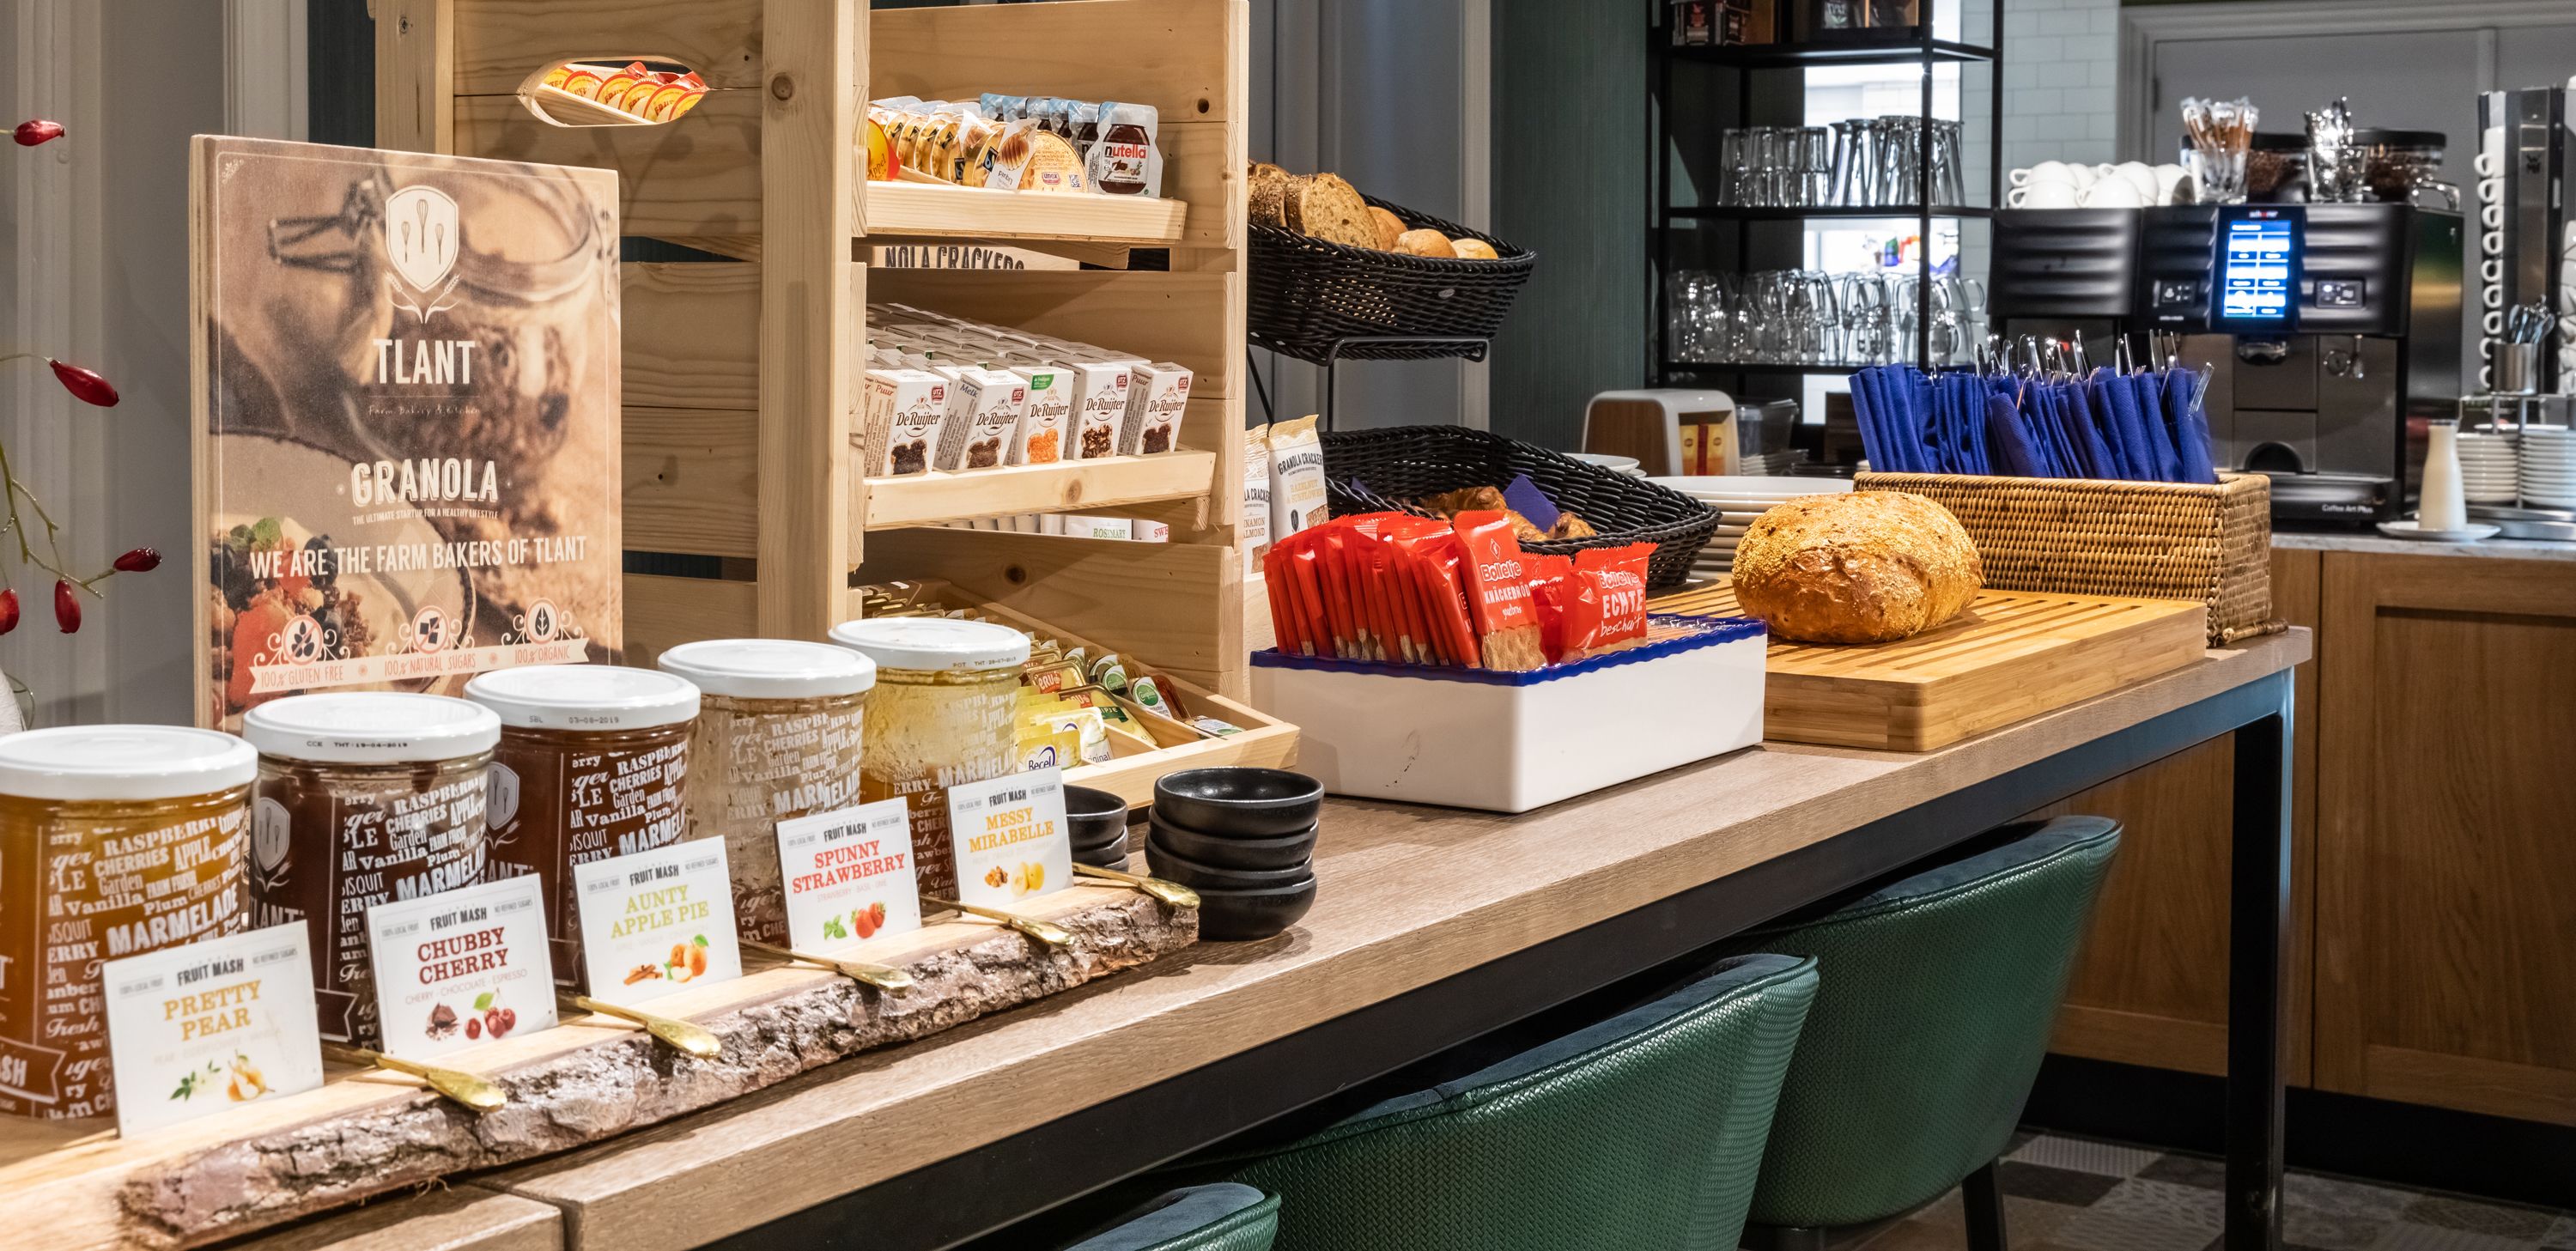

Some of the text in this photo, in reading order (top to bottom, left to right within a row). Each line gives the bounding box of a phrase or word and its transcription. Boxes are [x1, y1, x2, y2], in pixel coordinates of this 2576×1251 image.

[1104, 144, 1147, 159] nutella
[373, 338, 476, 384] TLANT
[876, 384, 894, 397] Puur
[960, 383, 979, 398] Melk
[1132, 374, 1149, 386] Puur
[1030, 403, 1068, 421] De Ruijter
[1085, 398, 1125, 416] De Ruijter
[1148, 399, 1185, 416] De Ruijter
[896, 411, 941, 430] De Ruijter
[976, 412, 1018, 429] De Ruijter
[1278, 455, 1302, 475] GRANOLA
[351, 458, 498, 507] GRANOLA
[353, 516, 365, 525] THE
[366, 511, 395, 524] ULTIMATE
[423, 507, 436, 517] FOR
[442, 508, 468, 518] HEALTHY
[469, 508, 498, 519] LIFESTYLE
[1092, 528, 1127, 539] ROSEMARY
[250, 536, 587, 580] WE ARE THE FARM BAKERS OF TLANT
[1480, 559, 1522, 582] Bolletje
[1597, 571, 1640, 590] Bolletje
[1484, 583, 1531, 604] KNÄCKEBRÖD
[1602, 589, 1644, 619] ECHTE
[1600, 616, 1643, 638] beschuit
[385, 653, 477, 677] 100% NATURAL SUGARS
[515, 645, 570, 665] 100% ORGANIC
[260, 665, 343, 688] 100% GLUTEN FREE
[763, 730, 819, 753] CHERRIES
[741, 764, 801, 783] Vanilla
[1028, 755, 1053, 770] Becel
[609, 765, 662, 794] CHERRIES
[613, 789, 646, 810] Garden
[989, 792, 1007, 807] FRUIT
[1008, 789, 1027, 802] MASH
[386, 805, 447, 835] CHERRIES
[586, 805, 647, 828] Vanilla
[645, 807, 671, 824] Plum
[986, 806, 1034, 831] MESSY
[389, 829, 428, 852] Garden
[823, 823, 867, 842] FRUIT MASH
[969, 820, 1054, 853] MIRABELLE
[94, 835, 213, 878] CHERRIES APPLE
[359, 846, 428, 871] Vanilla
[427, 848, 461, 867] Plum
[814, 840, 879, 869] SPUNNY
[99, 873, 143, 896] Garden
[629, 865, 679, 886] FRUIT MASH
[793, 853, 906, 894] STRAWBERRY
[65, 892, 145, 915] Vanilla
[143, 894, 188, 916] Plum
[625, 884, 688, 914] AUNTY
[106, 882, 239, 956] MARMELADE
[430, 907, 487, 932] FRUIT MASH
[611, 908, 673, 939] APPLE
[679, 902, 709, 921] PIE
[417, 926, 505, 963] CHUBBY
[177, 958, 244, 987] FRUIT MASH
[419, 949, 508, 985] CHERRY
[163, 980, 261, 1021] PRETTY
[46, 1015, 100, 1039] Fresh
[180, 1007, 252, 1041] PEAR
